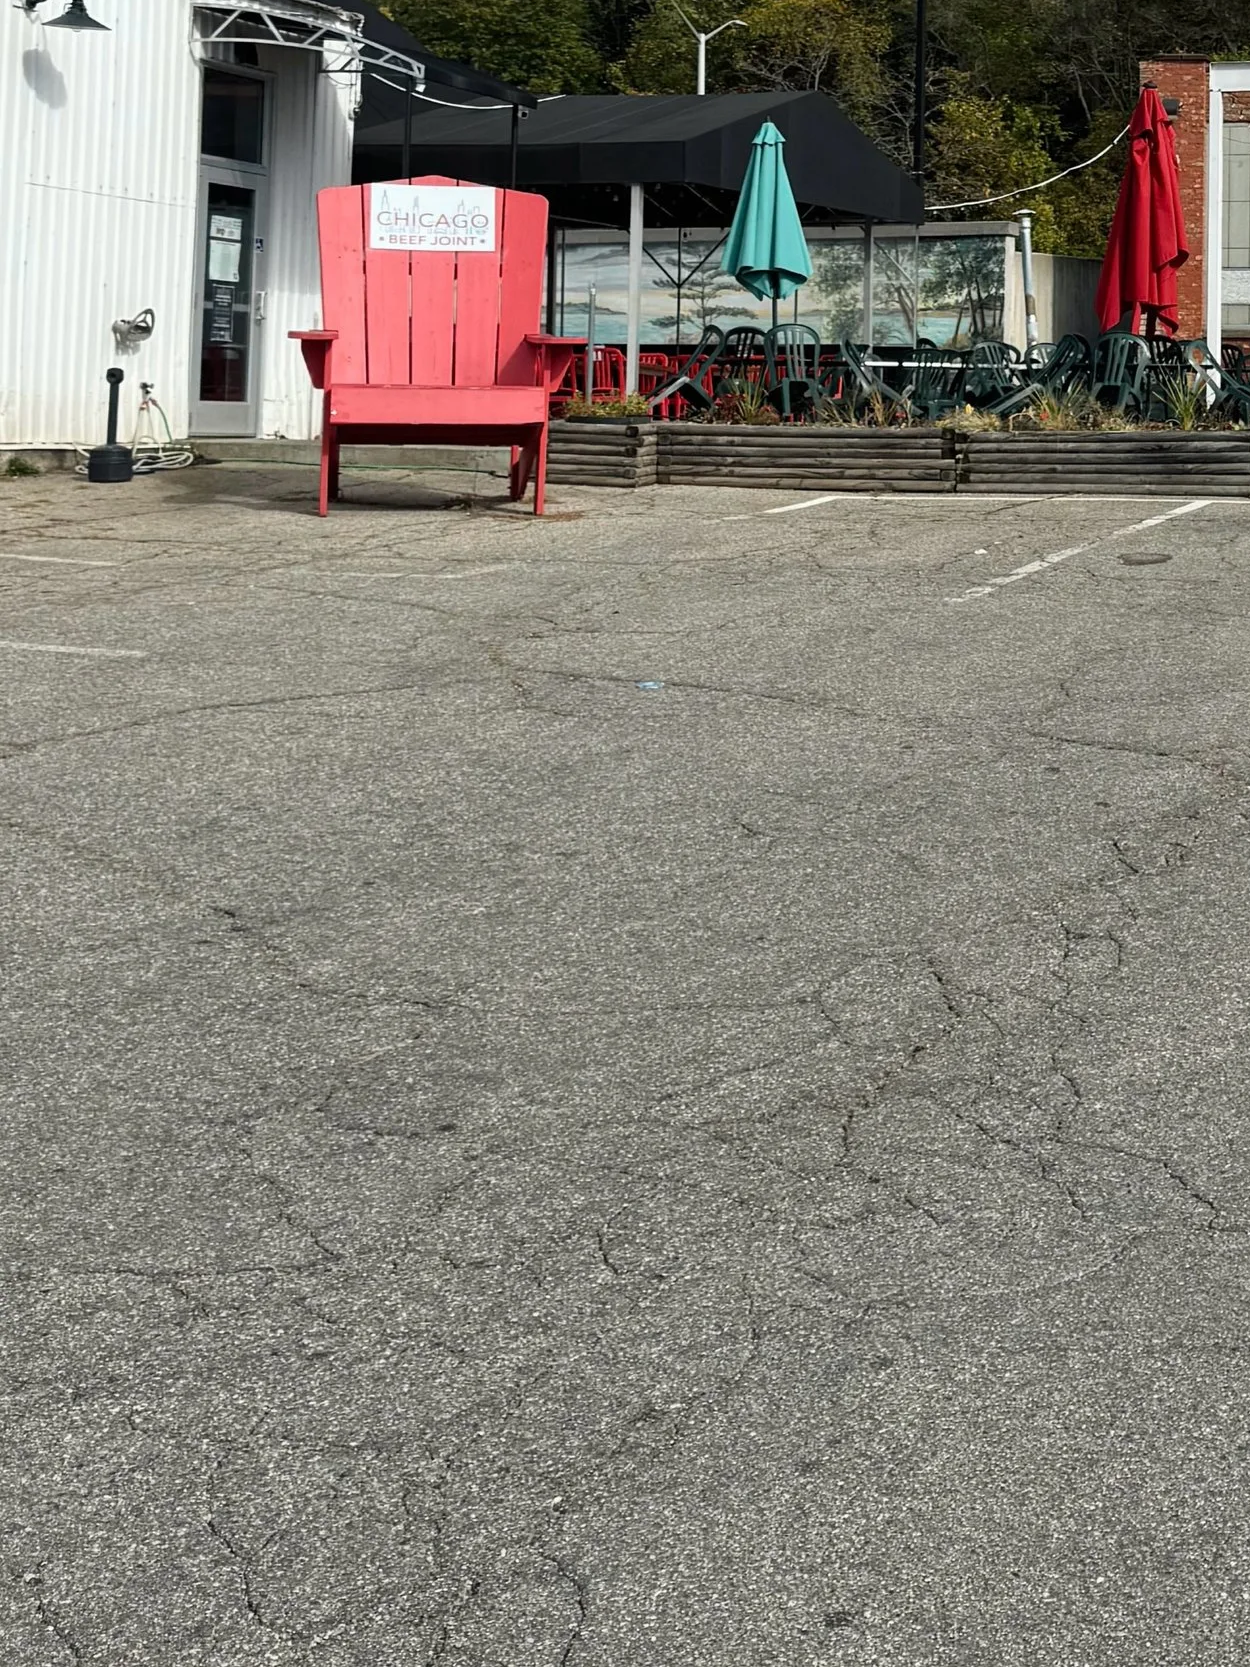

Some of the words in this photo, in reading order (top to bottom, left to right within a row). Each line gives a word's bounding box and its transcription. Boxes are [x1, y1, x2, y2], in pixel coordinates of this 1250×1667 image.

[376, 210, 489, 229] CHICAGO
[388, 234, 427, 245] BEEF
[430, 236, 477, 246] JOINT
